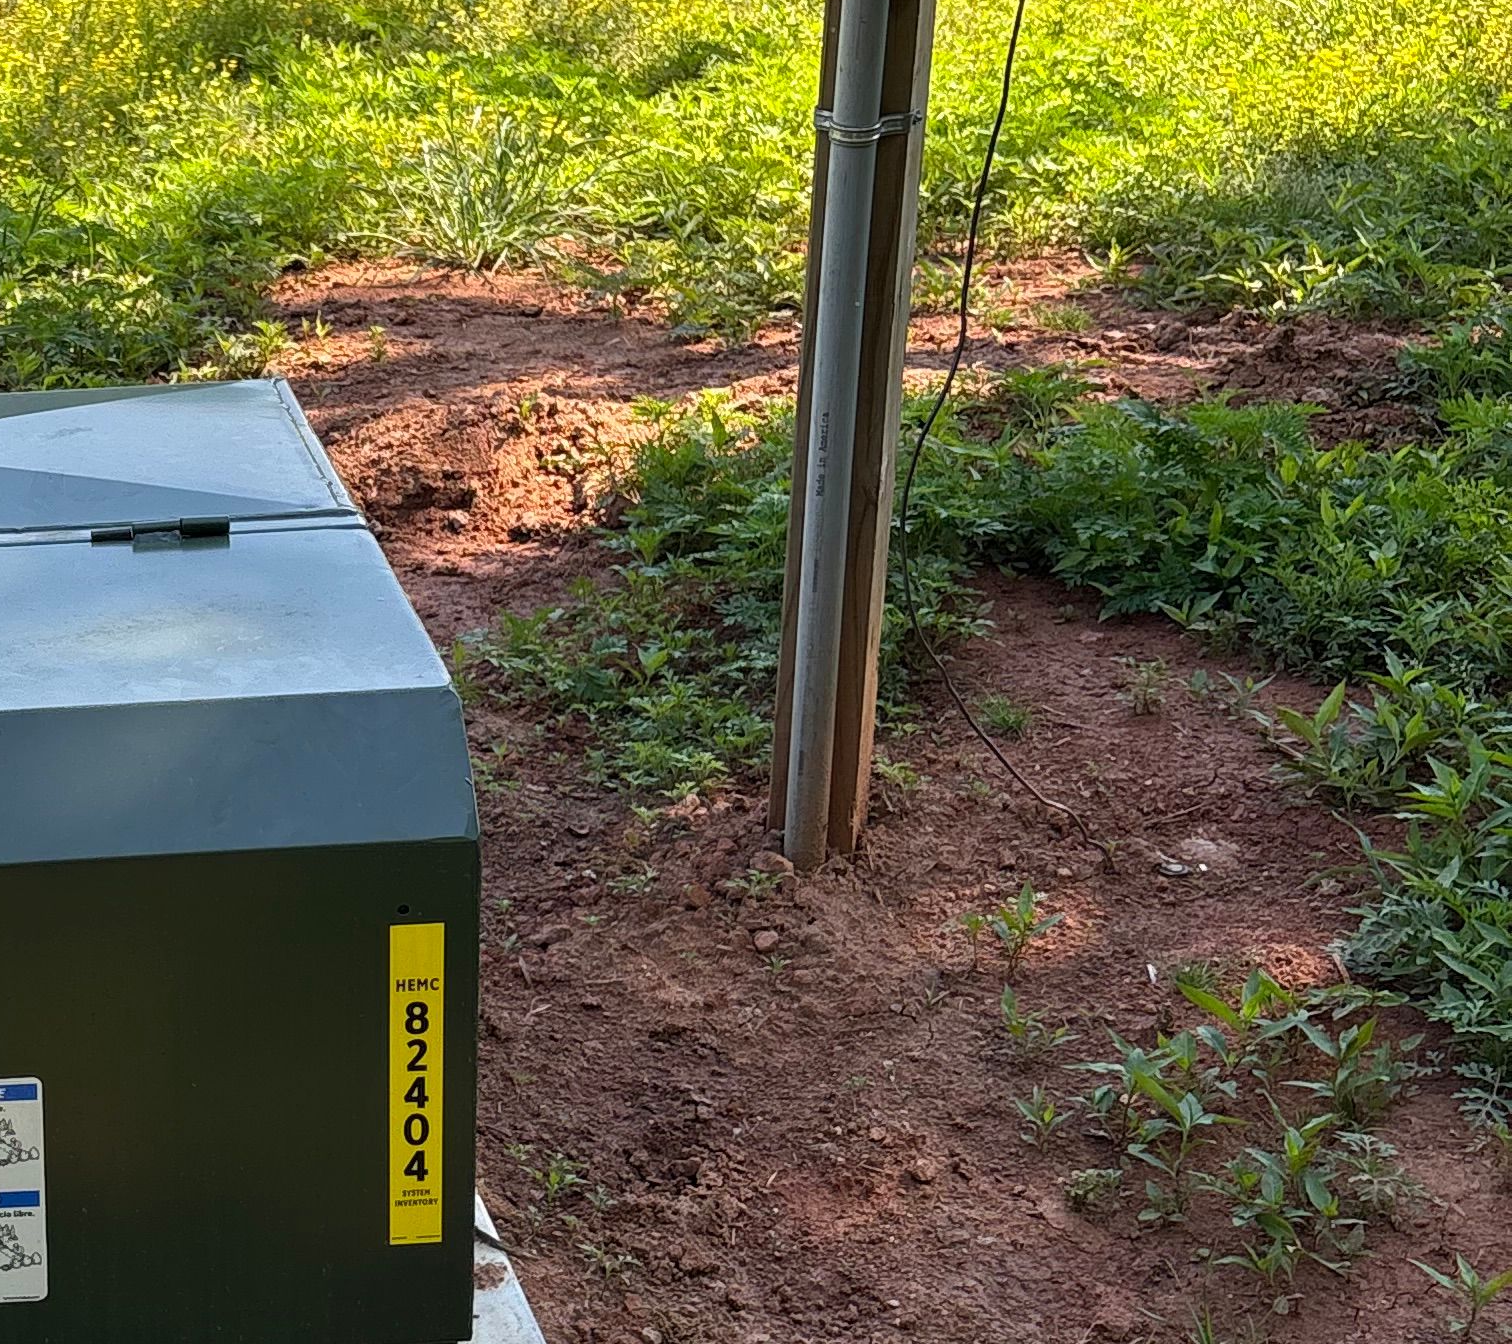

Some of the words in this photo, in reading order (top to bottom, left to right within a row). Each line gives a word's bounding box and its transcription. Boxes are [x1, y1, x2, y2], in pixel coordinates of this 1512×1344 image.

[818, 412, 830, 453] America
[817, 457, 826, 468] in
[816, 474, 825, 497] Made
[395, 977, 440, 993] HEMC
[403, 1001, 430, 1182] 82404
[402, 1189, 431, 1197] SYSTEM
[395, 1198, 439, 1207] INVENTORY
